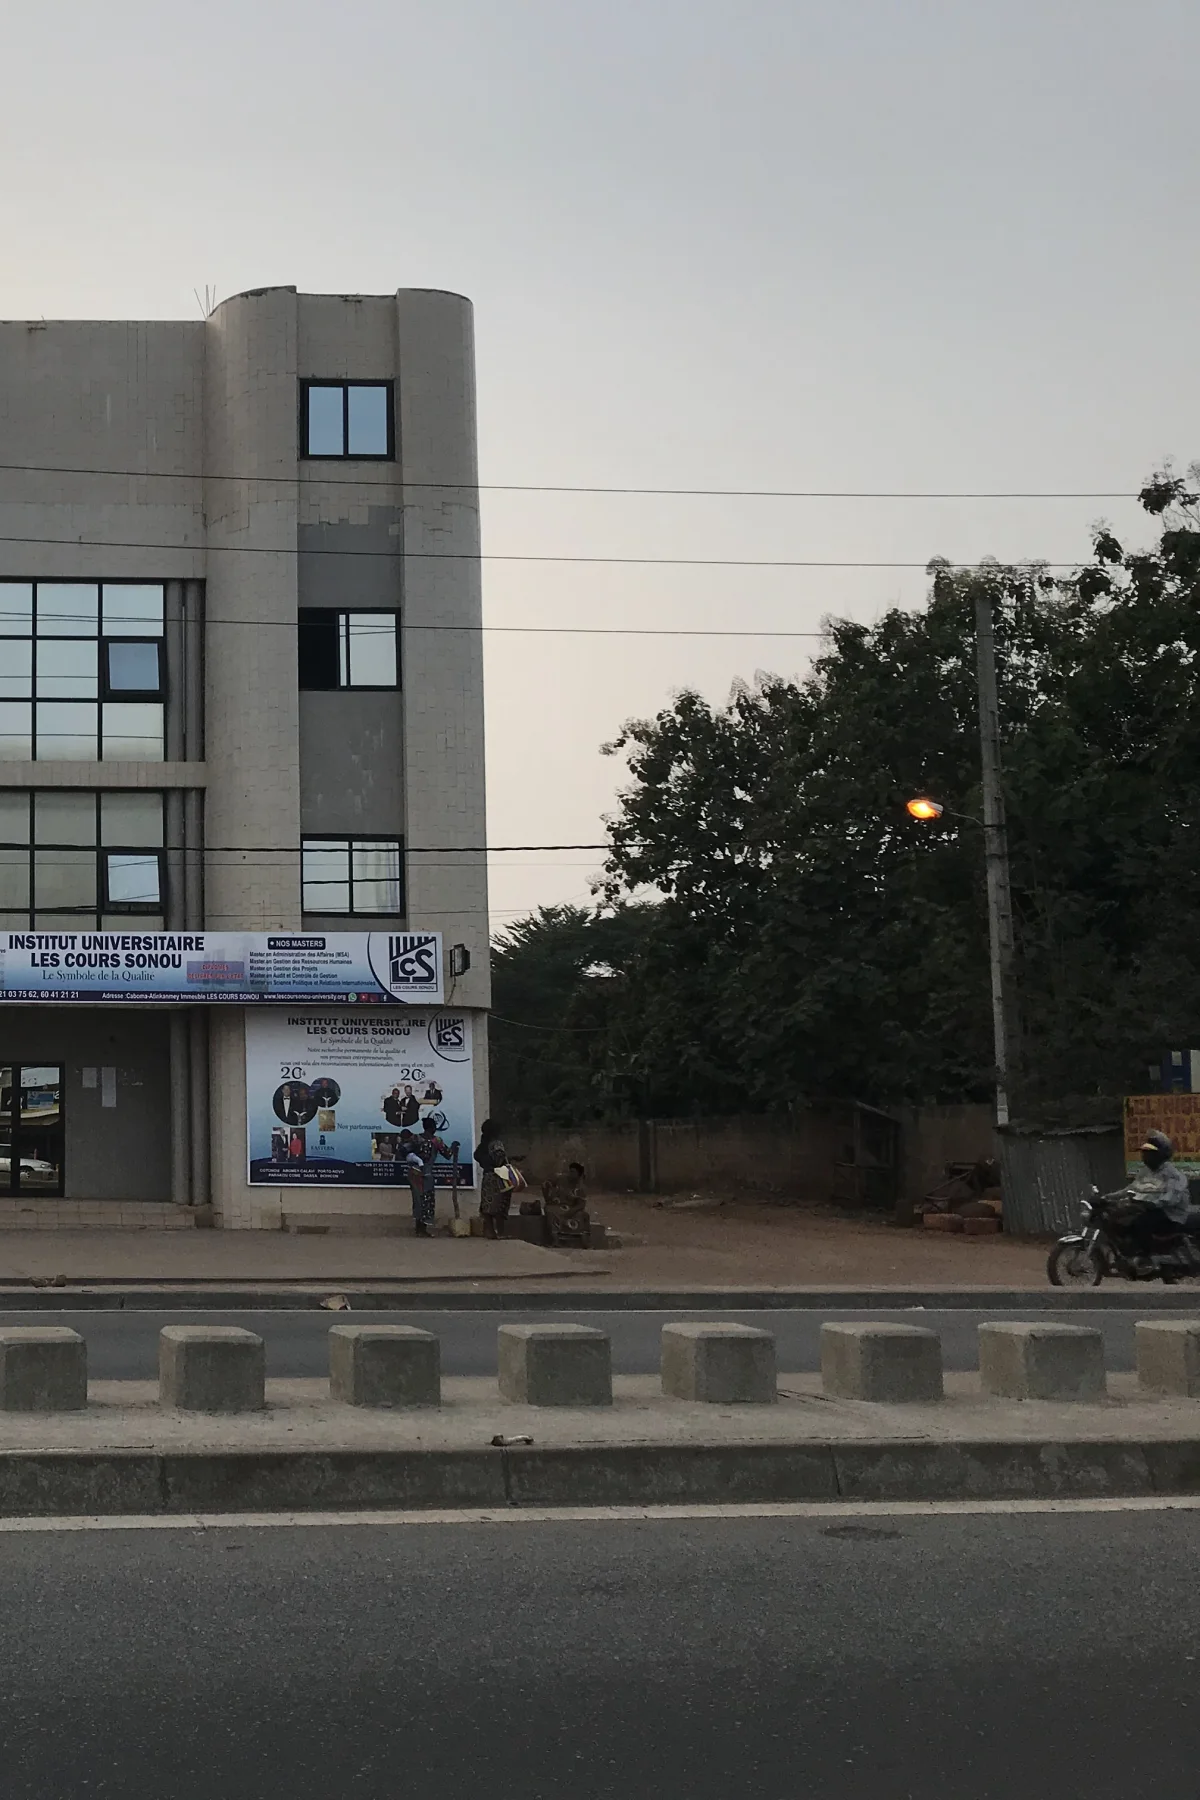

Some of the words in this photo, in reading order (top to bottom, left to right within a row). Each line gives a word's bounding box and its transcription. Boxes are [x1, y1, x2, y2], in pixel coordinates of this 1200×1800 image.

[9, 935, 77, 950] INSTITUT
[81, 935, 204, 951] UNIVERSITAIRE
[31, 953, 60, 967] LES
[64, 953, 120, 968] COURS
[125, 953, 182, 968] SONOU
[42, 970, 55, 980] Le
[57, 970, 96, 981] Symbole
[97, 970, 109, 980] de
[111, 970, 119, 980] la
[122, 970, 155, 980] Qualité
[288, 1018, 338, 1026] INSTITUT
[342, 1018, 426, 1027] UNIVERSITIRE
[307, 1027, 327, 1035] LES
[330, 1027, 368, 1035] COURS
[371, 1027, 410, 1035] SONOU
